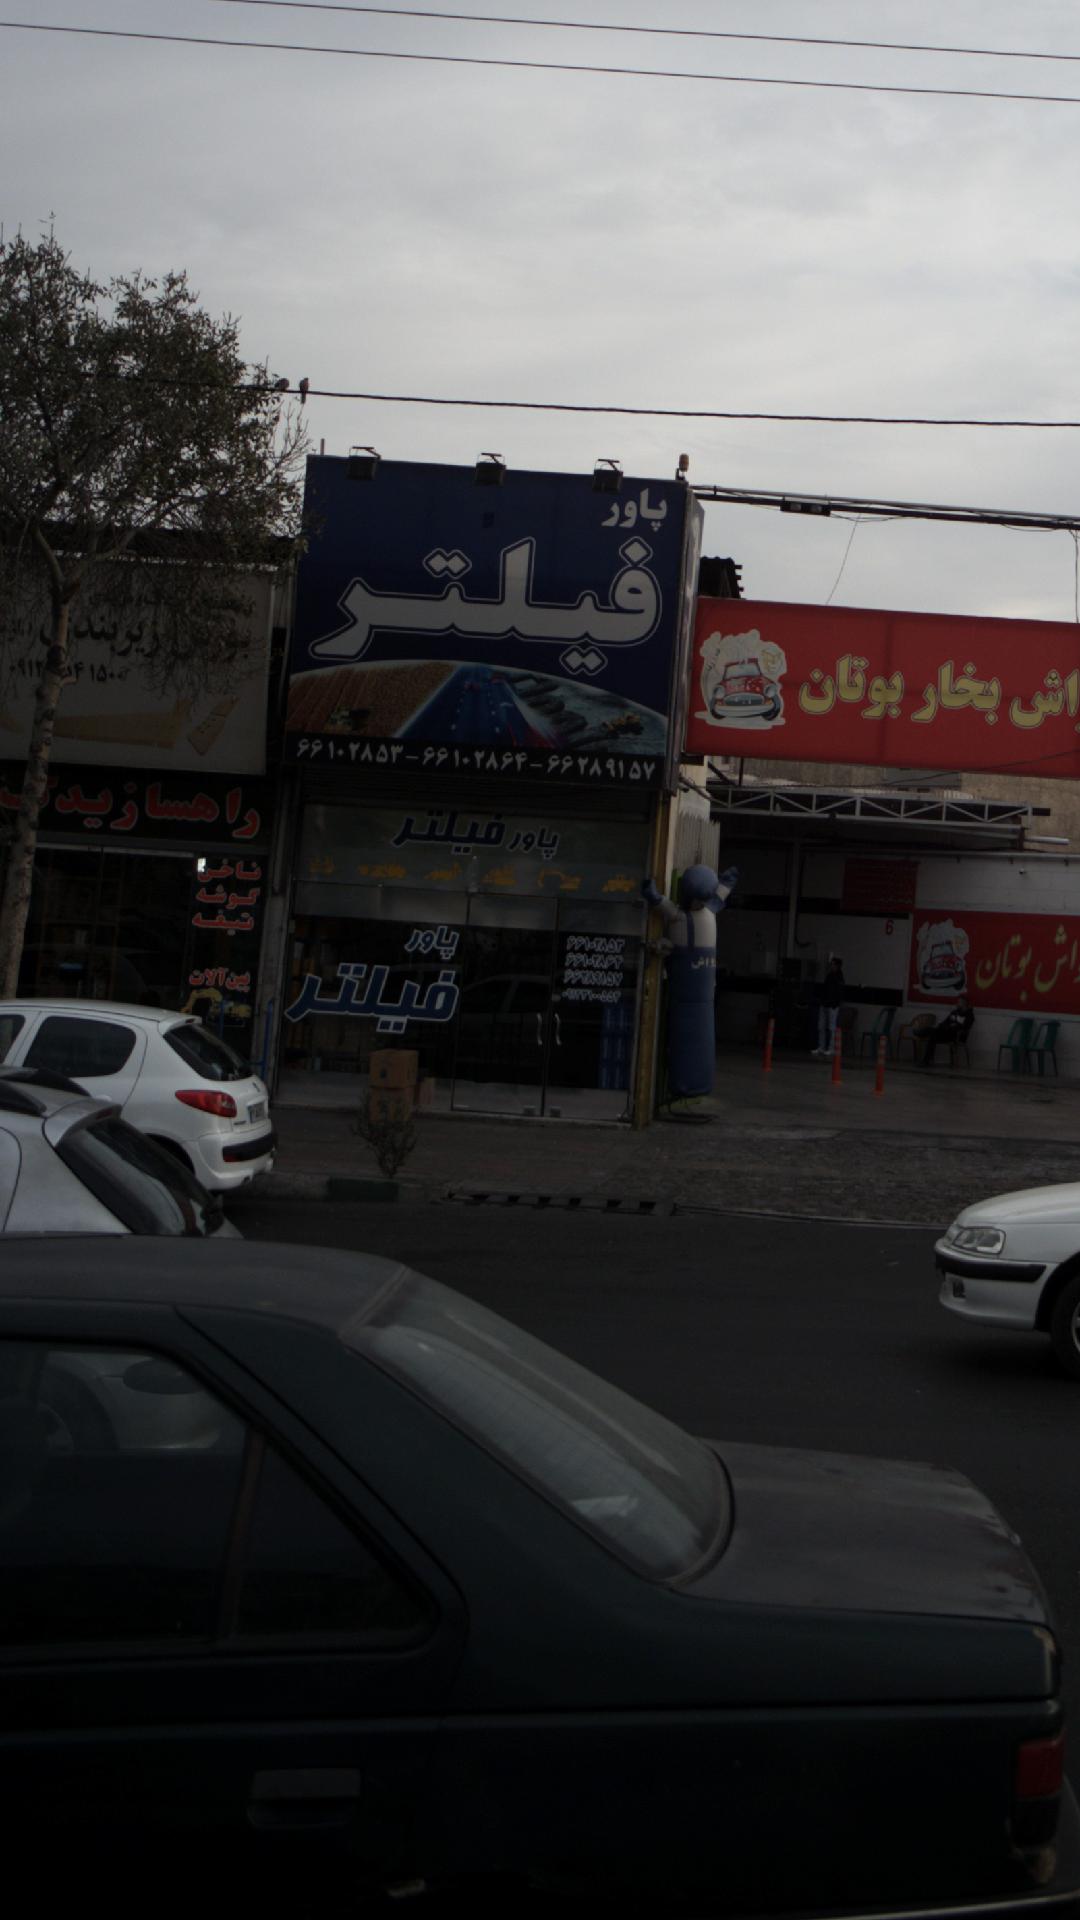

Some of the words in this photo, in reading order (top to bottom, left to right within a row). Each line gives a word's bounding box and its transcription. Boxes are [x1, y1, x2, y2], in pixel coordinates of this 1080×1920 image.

[601, 488, 668, 533] پاور
[307, 535, 664, 677] فیلتر
[798, 653, 906, 721] بوتان
[911, 660, 1002, 725] بخار
[1009, 668, 1080, 737] اش
[390, 810, 507, 855] فیلتر
[507, 825, 561, 862] پاور
[403, 925, 461, 960] پاور
[975, 933, 1033, 1004] بوتان
[284, 961, 461, 1035] فیلتر
